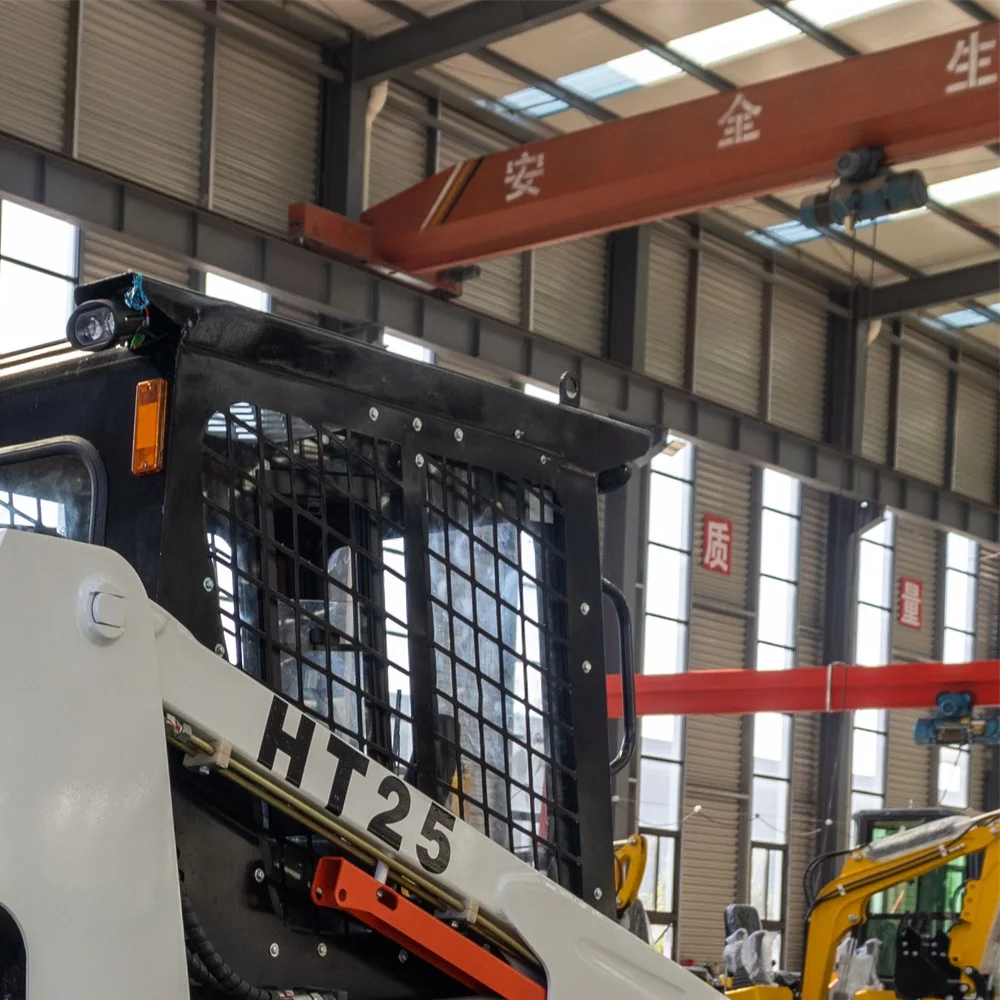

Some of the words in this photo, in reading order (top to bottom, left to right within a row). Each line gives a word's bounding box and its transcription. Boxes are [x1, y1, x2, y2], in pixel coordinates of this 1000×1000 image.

[505, 151, 545, 201] 安
[717, 93, 762, 148] 全
[945, 31, 1000, 95] 生
[704, 520, 730, 572] 质
[901, 580, 920, 626] 量
[257, 694, 456, 874] HT25
